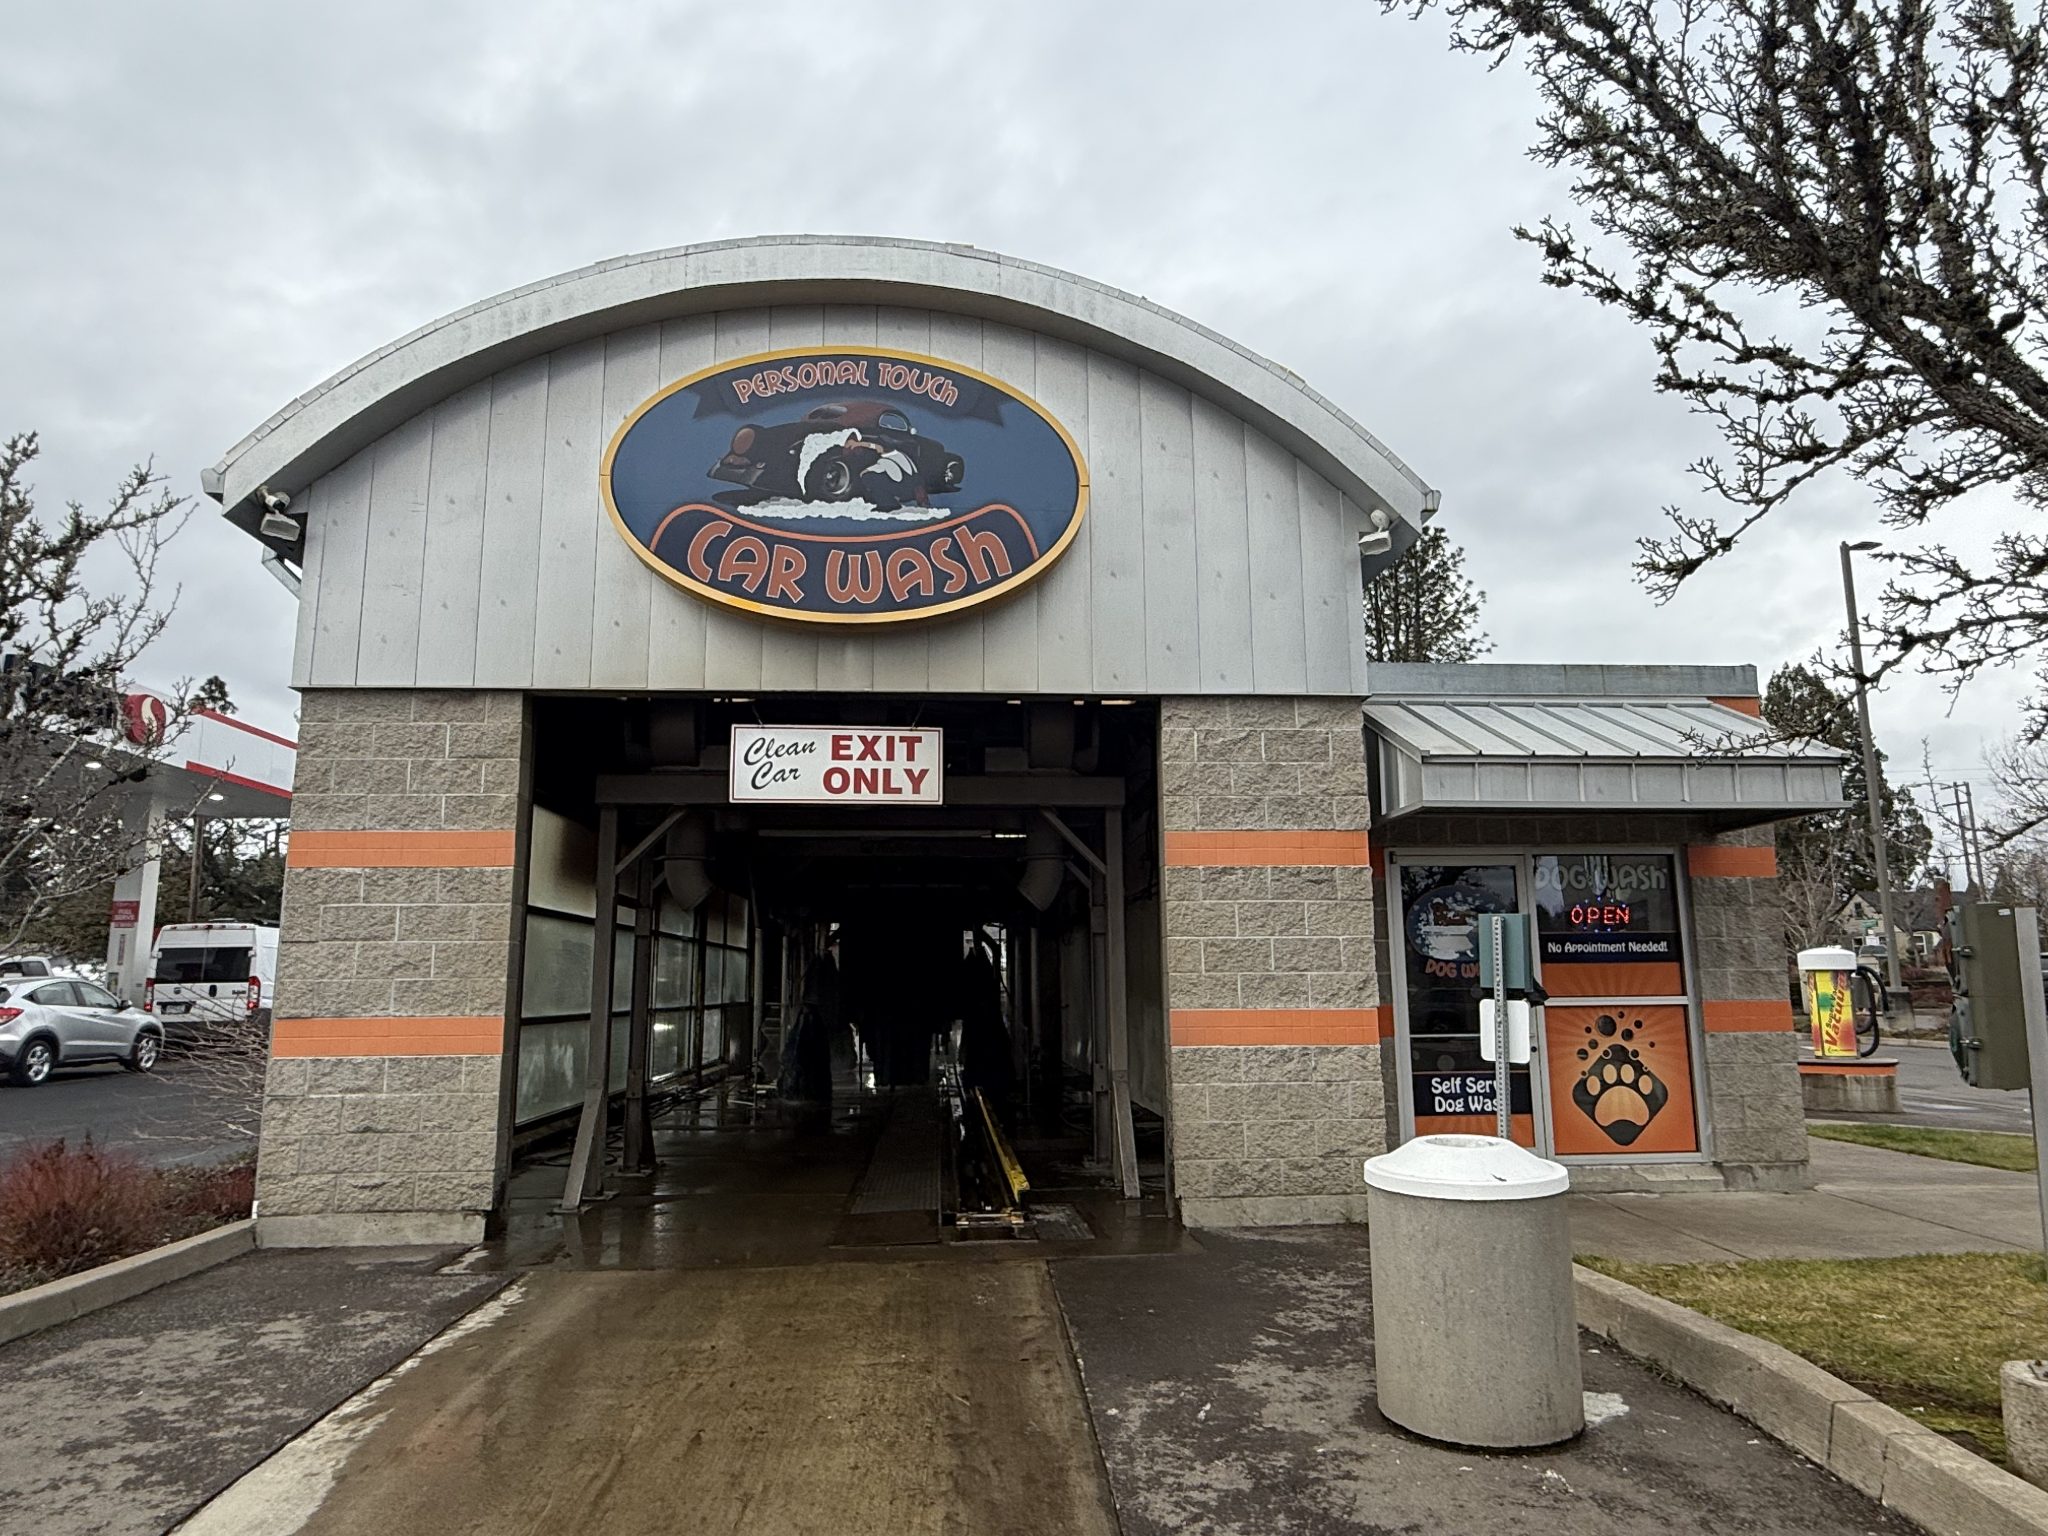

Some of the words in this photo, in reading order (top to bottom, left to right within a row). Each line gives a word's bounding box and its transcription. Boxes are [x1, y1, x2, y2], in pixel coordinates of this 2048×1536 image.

[687, 521, 807, 603] CAR
[743, 737, 816, 766] Clean
[831, 734, 922, 762] EXIT
[751, 761, 801, 790] Car
[822, 766, 930, 795] ONLY
[1570, 906, 1630, 925] OPEN
[1547, 942, 1562, 953] No
[1564, 941, 1626, 953] Appointment
[1628, 941, 1668, 952] Needed!
[1425, 959, 1457, 978] DOG
[1431, 1077, 1461, 1094] Self
[1434, 1096, 1465, 1112] Dog
[1468, 1095, 1498, 1112] Was
